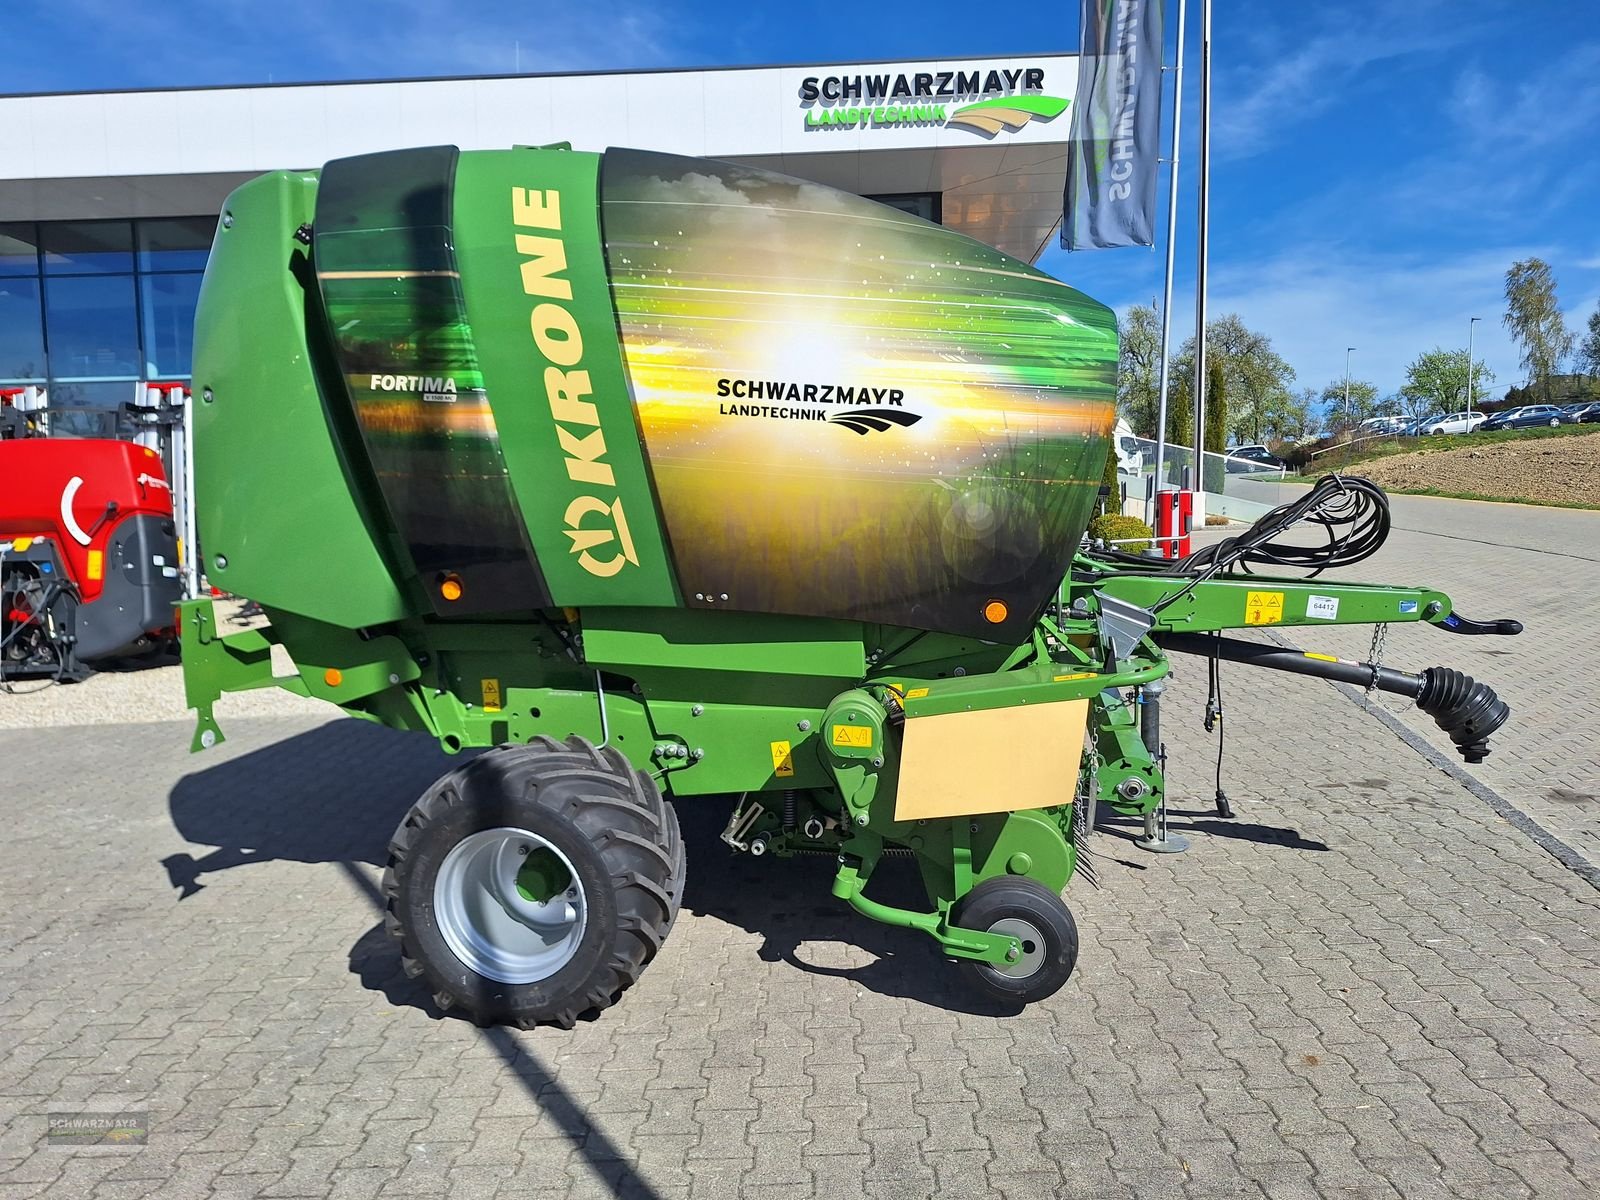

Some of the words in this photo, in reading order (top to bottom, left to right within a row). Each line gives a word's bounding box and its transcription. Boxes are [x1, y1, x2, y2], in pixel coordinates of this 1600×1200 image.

[801, 68, 1045, 100] SCHWARZMAYR
[807, 104, 947, 126] LANDTECHNIK
[512, 186, 616, 487] KRONE
[370, 374, 457, 393] FORTIMA
[717, 379, 904, 406] SCHWARZMAYR
[720, 404, 827, 421] LANDTECHNIK
